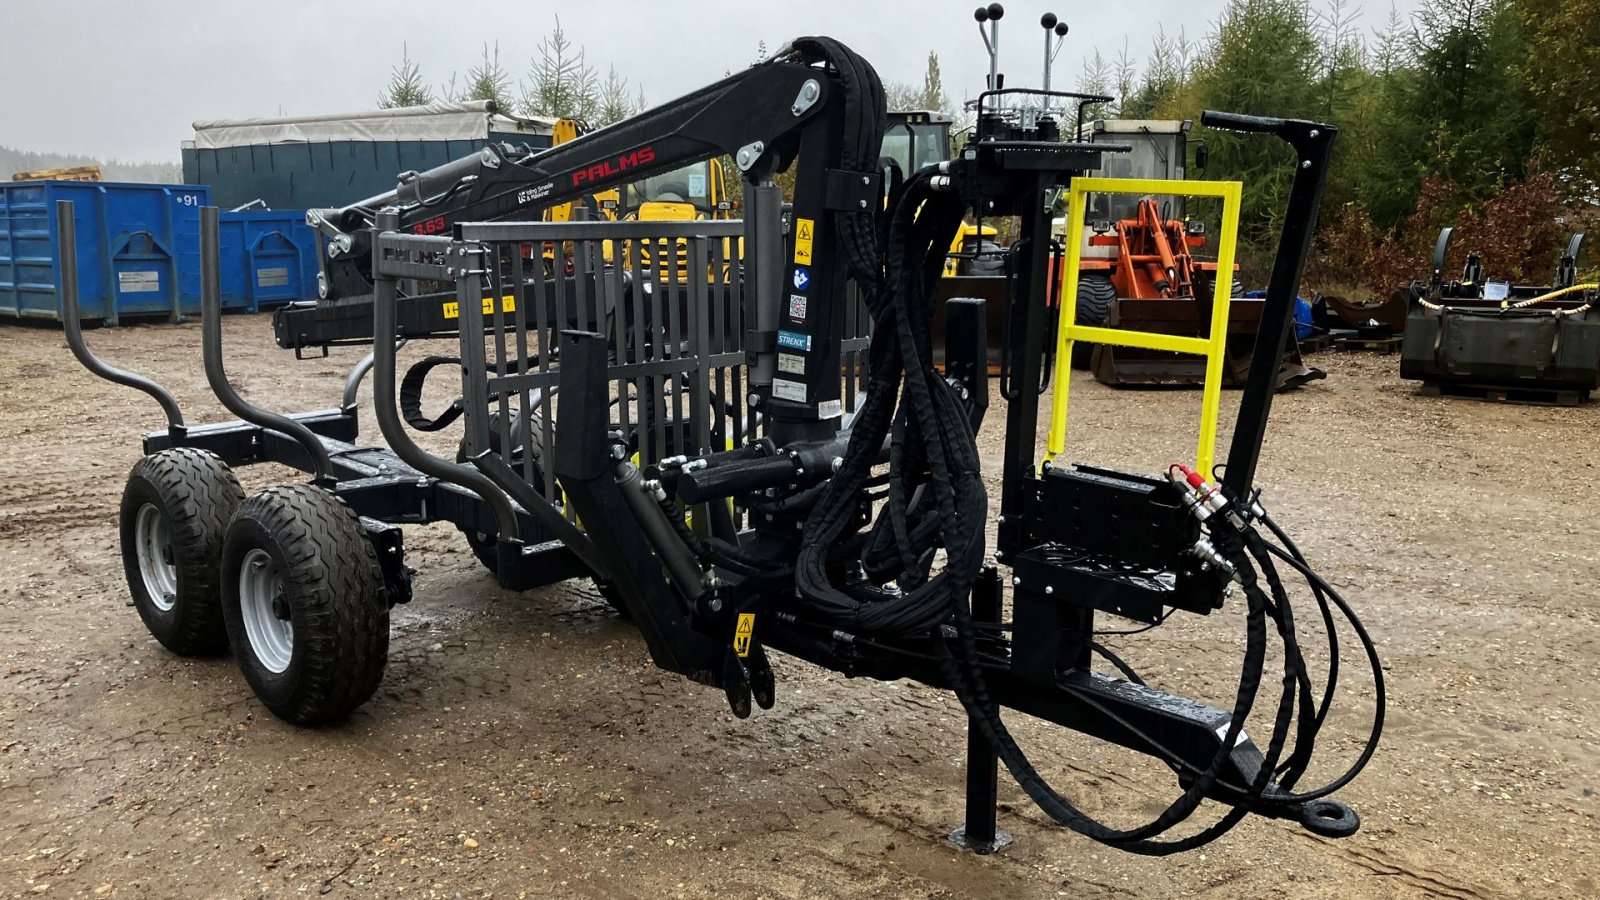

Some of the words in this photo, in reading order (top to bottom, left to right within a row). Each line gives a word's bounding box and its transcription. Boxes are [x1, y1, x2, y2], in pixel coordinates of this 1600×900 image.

[573, 147, 656, 186] PALMS
[184, 195, 198, 206] 91
[414, 216, 446, 235] 3.63
